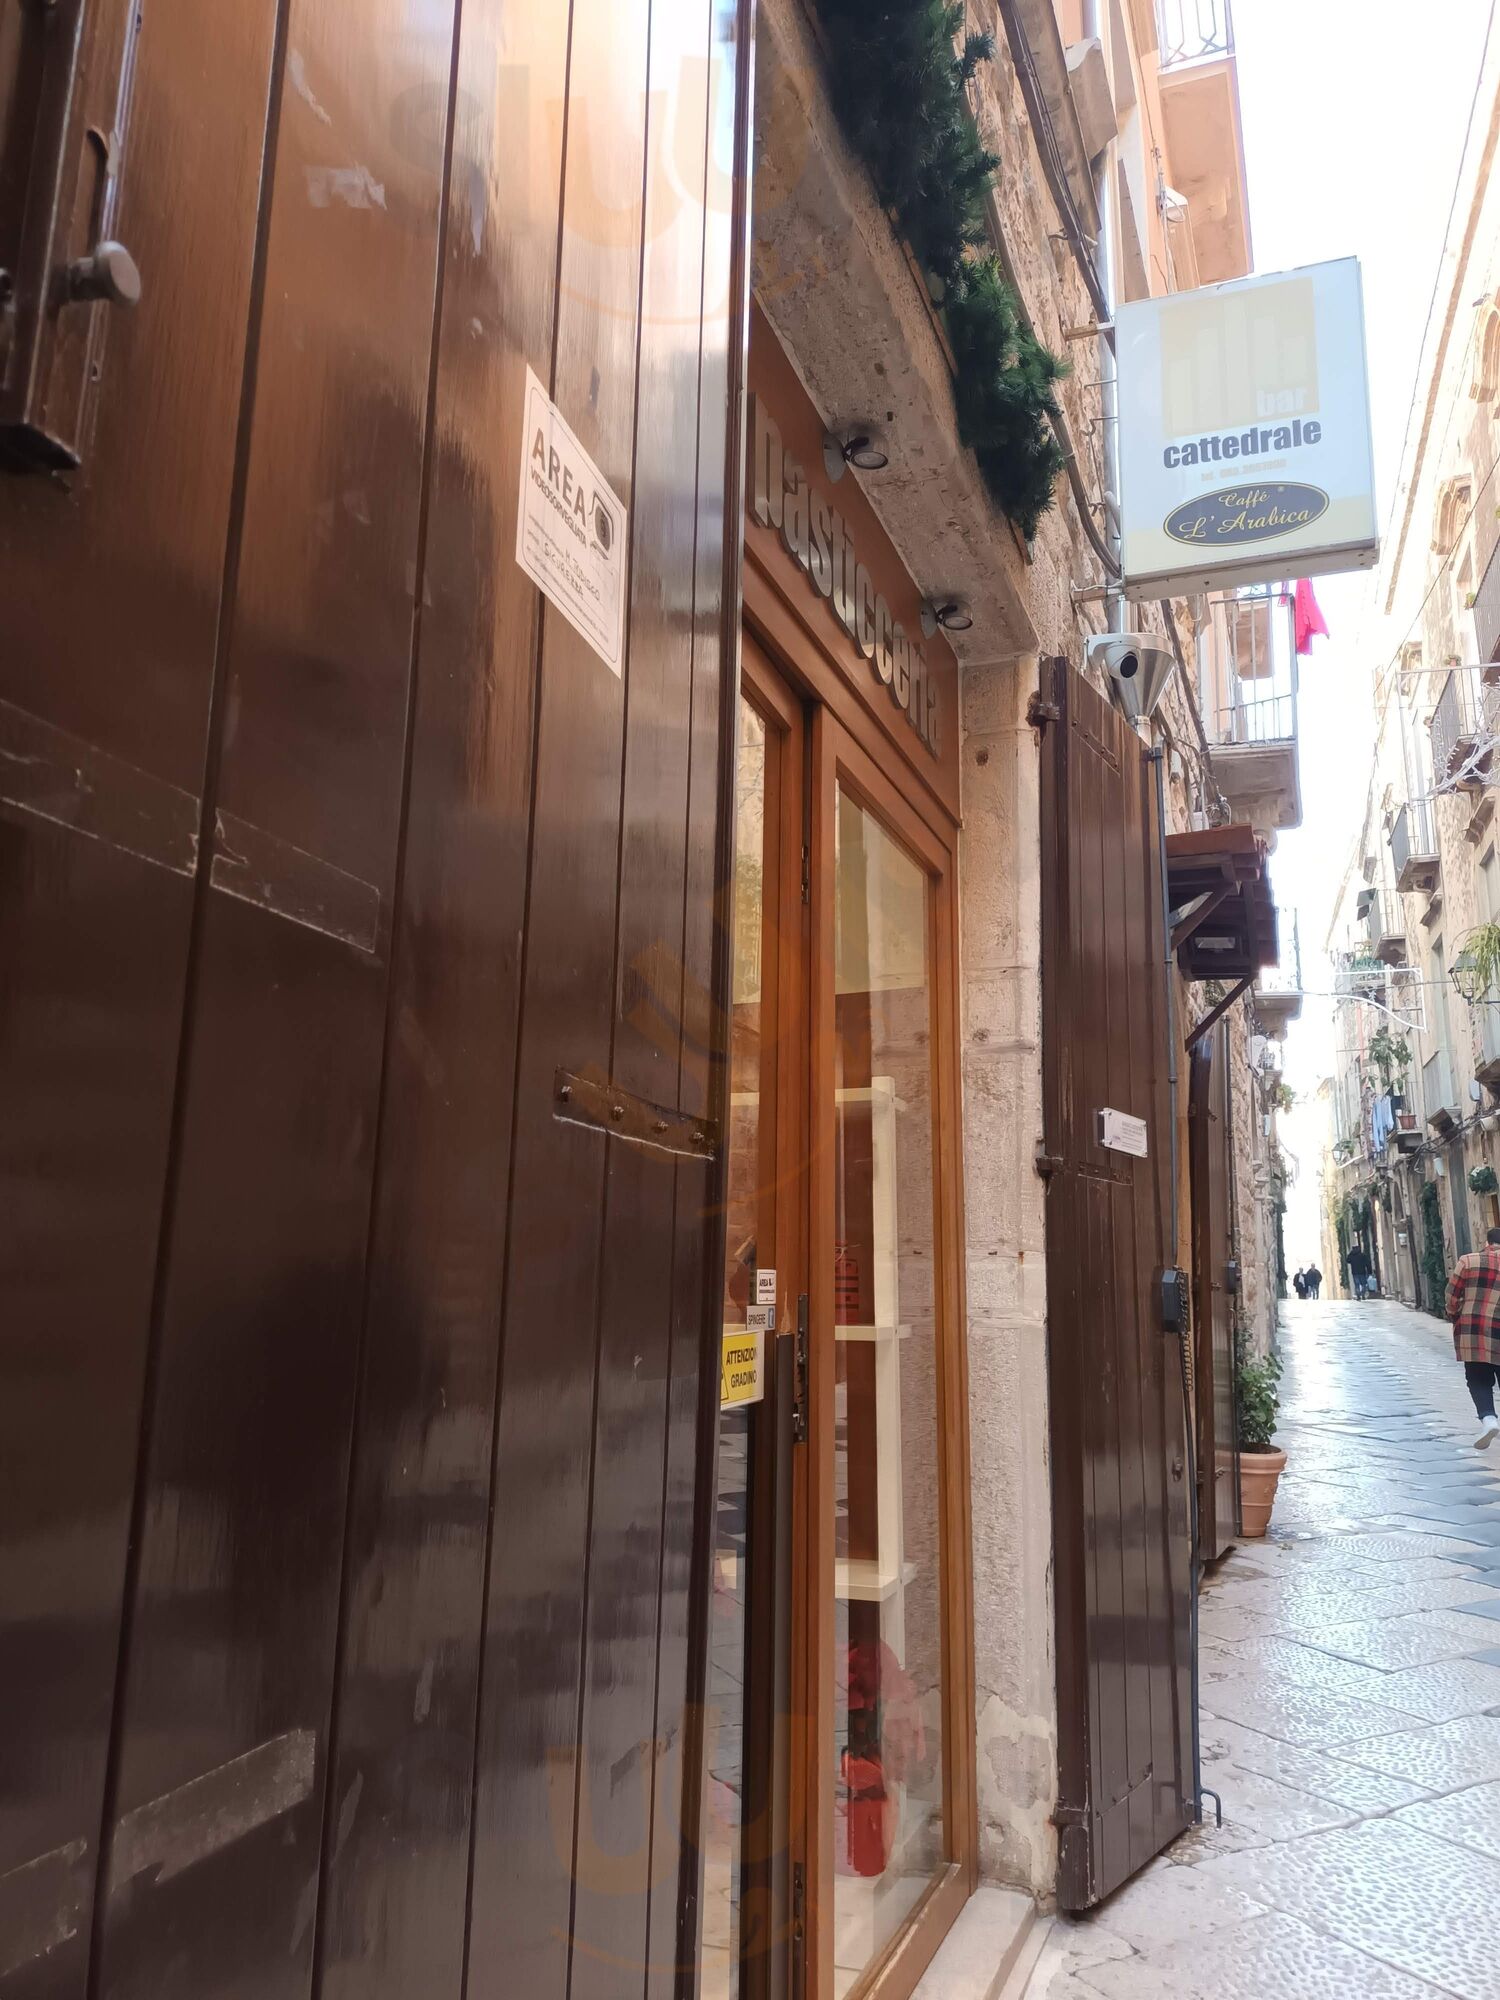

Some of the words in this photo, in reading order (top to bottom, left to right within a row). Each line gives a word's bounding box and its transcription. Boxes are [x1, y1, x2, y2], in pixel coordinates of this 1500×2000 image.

[1163, 418, 1322, 469] cattedrale
[532, 427, 587, 528] AREA
[726, 1347, 758, 1365] ATTENZION
[730, 1369, 757, 1388] GRADINO
